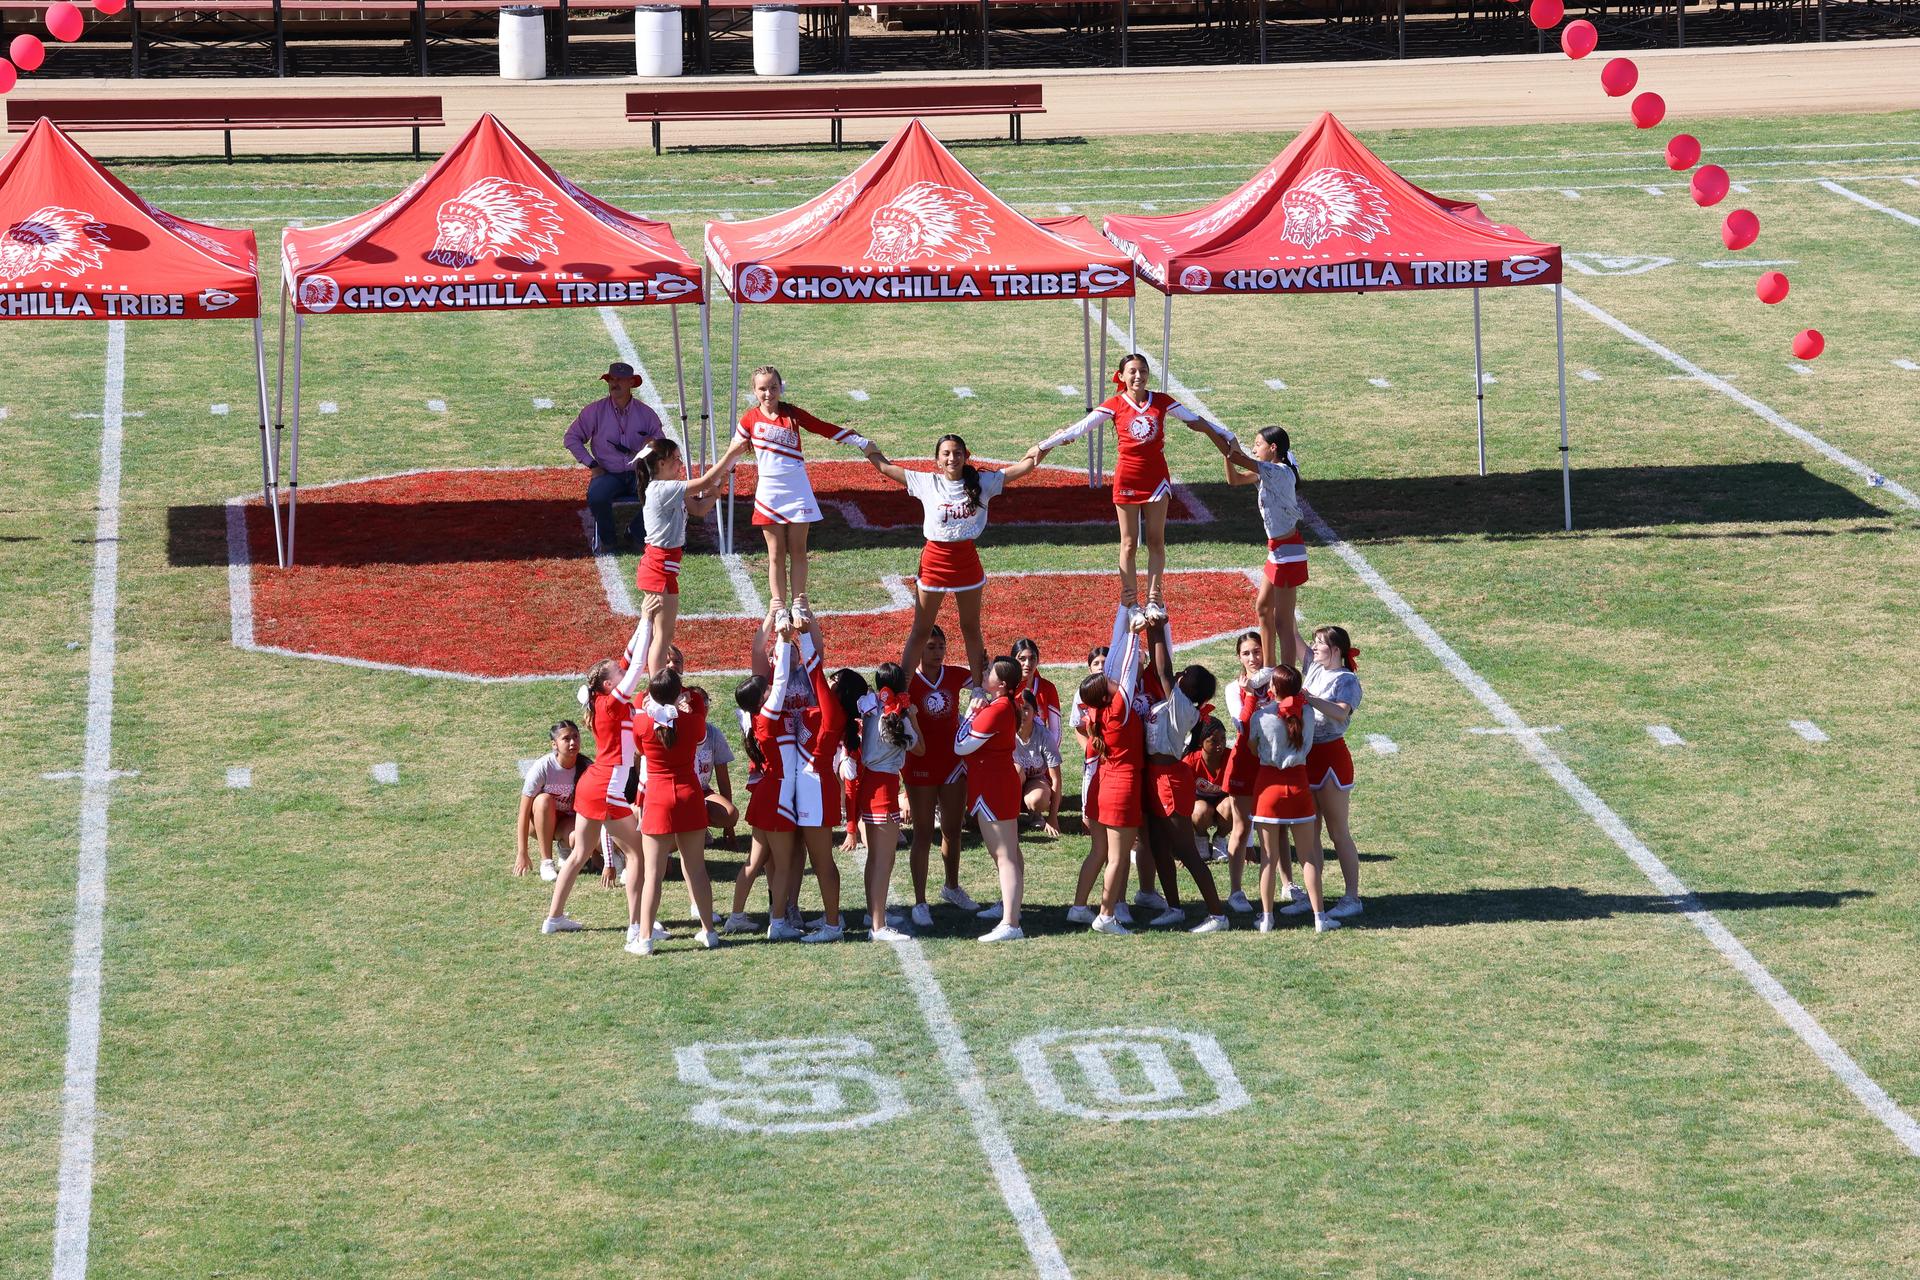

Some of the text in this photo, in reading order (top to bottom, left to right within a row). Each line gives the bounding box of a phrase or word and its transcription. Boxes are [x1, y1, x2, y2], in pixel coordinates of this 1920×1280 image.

[404, 274, 476, 283] HOME
[539, 272, 584, 280] THE
[841, 263, 1017, 273] HOME OF THE
[1223, 259, 1488, 290] CHOWCHILLA TRIBE
[41, 281, 68, 289] OF
[85, 283, 129, 291] THE
[343, 281, 645, 309] CHOWCHILLA TRIBE
[781, 273, 1077, 299] CHOWCHILLA TRIBE
[101, 293, 185, 316] TRIBE
